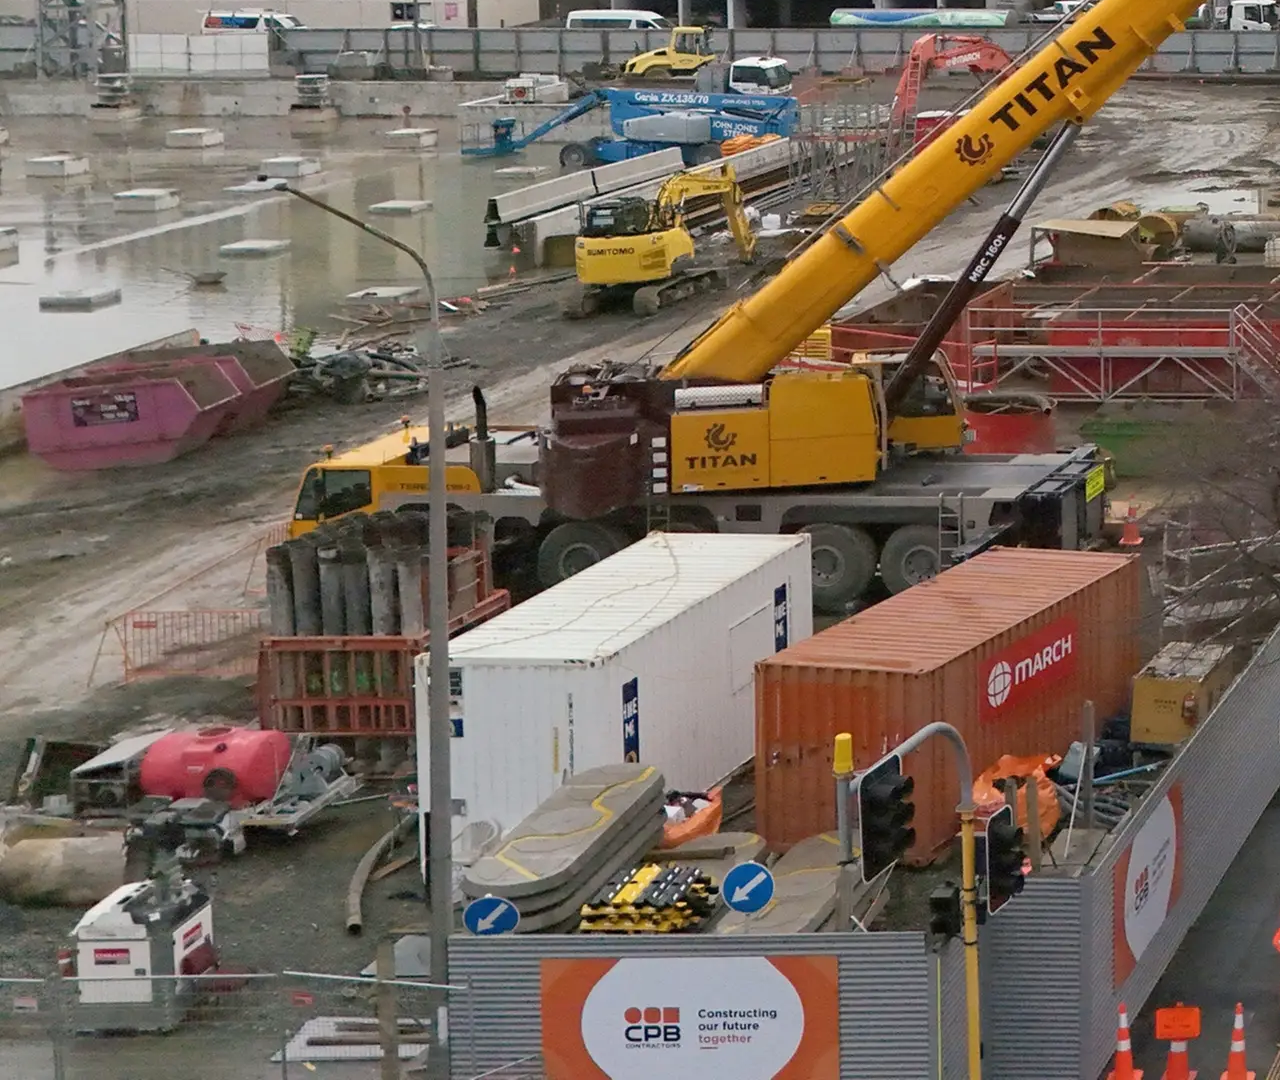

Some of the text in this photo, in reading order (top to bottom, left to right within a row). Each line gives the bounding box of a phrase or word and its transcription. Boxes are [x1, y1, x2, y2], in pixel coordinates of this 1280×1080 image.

[988, 26, 1117, 132] TITAN
[635, 92, 709, 104] Genie ZX-135/70
[712, 121, 758, 133] JOHN JONES
[587, 247, 635, 256] SUMITOMO
[969, 233, 1007, 282] MRC 160t
[685, 453, 757, 469] TITAN
[1015, 633, 1072, 686] MARCH
[698, 1008, 778, 1020] Constructing
[698, 1020, 760, 1032] our future
[624, 1025, 682, 1042] CPB
[698, 1033, 753, 1045] together
